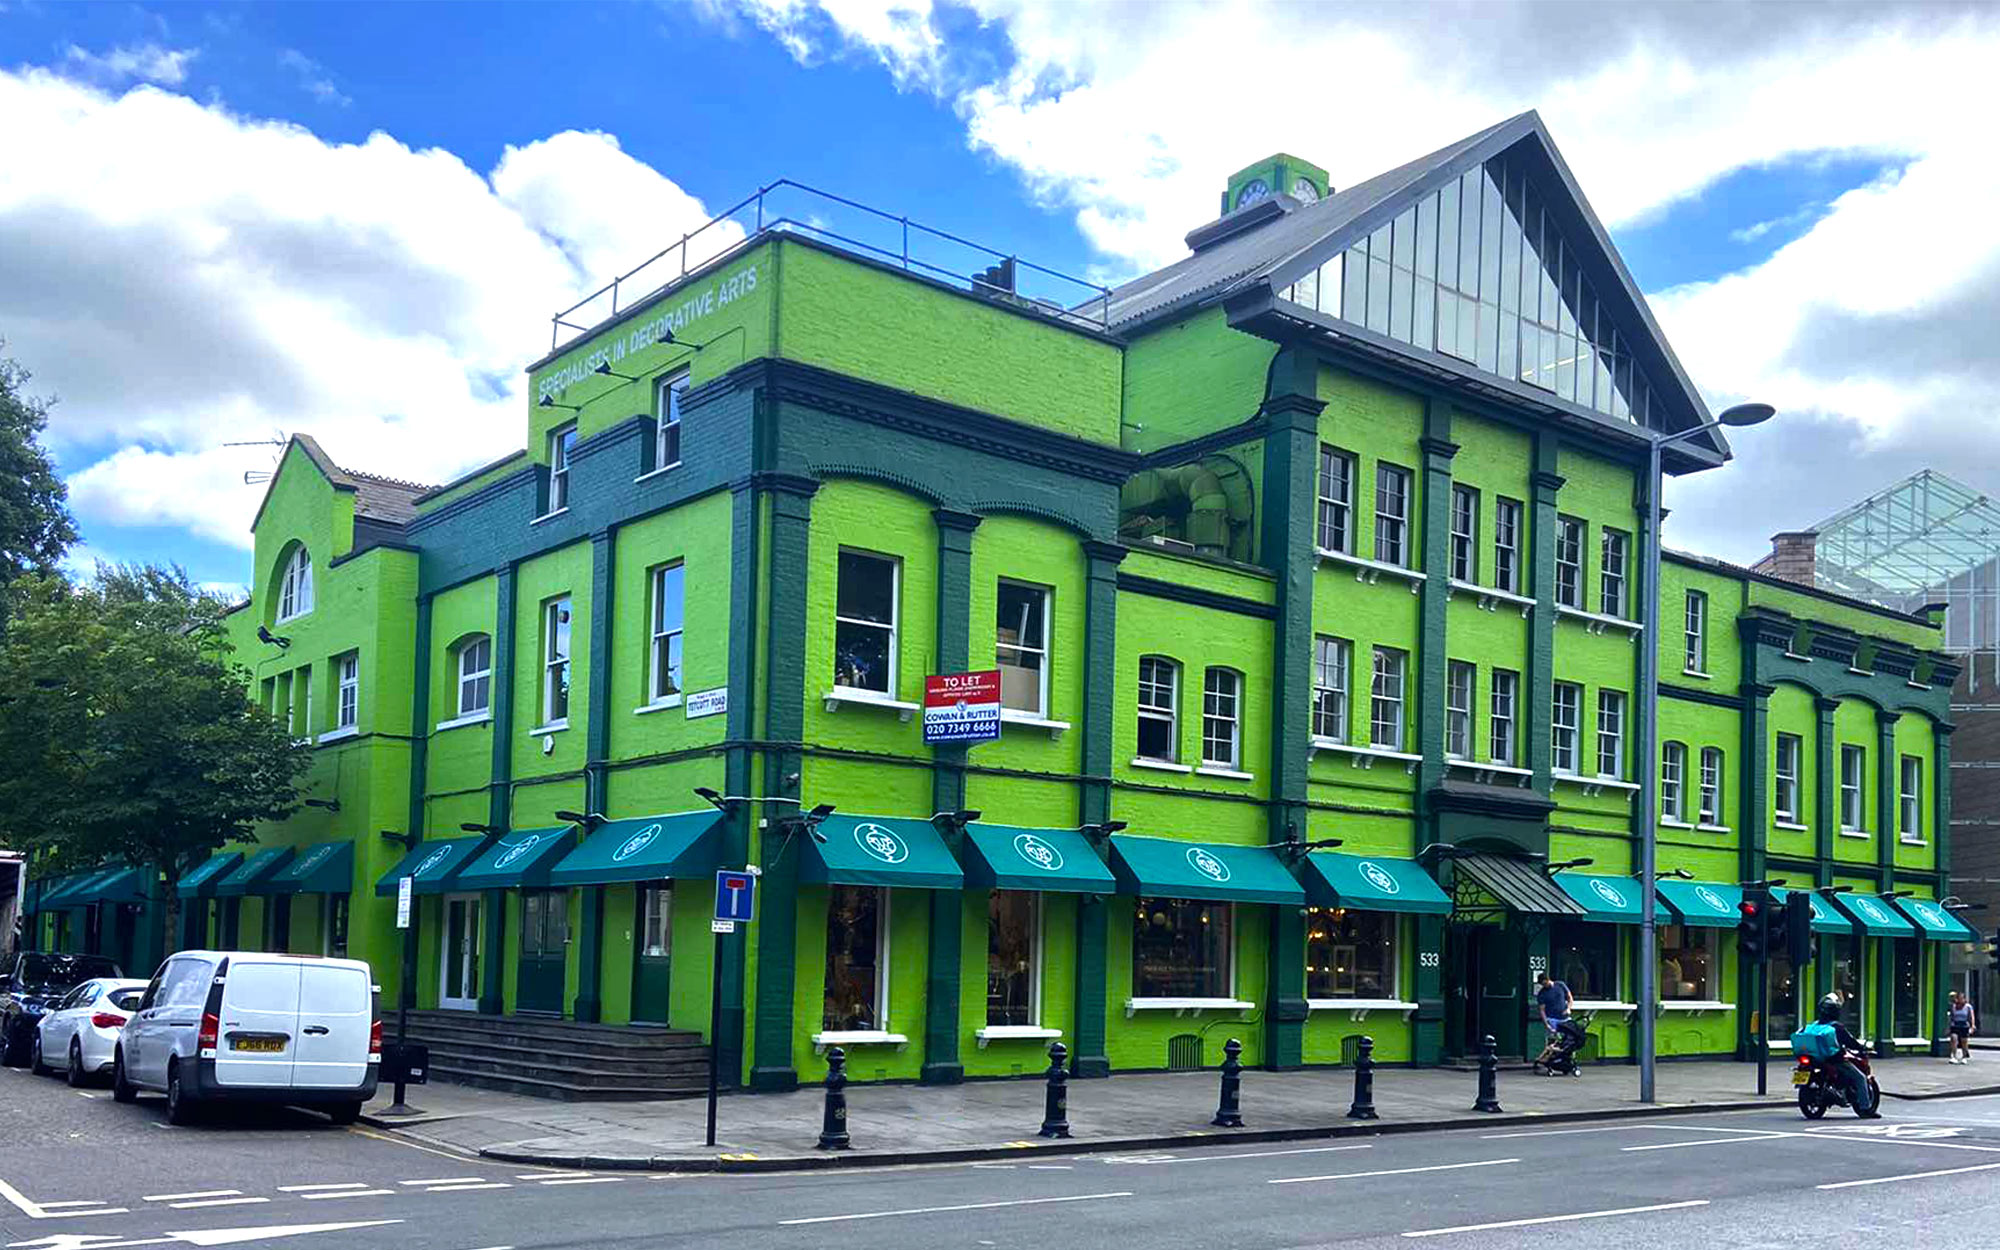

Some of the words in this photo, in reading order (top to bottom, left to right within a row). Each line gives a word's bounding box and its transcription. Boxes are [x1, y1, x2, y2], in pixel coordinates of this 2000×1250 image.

[614, 339, 625, 362] IN
[630, 288, 714, 354] DECORATIVE
[718, 265, 758, 309] ARTS
[943, 677, 959, 687] TO
[961, 676, 981, 686] LET
[926, 713, 958, 722] COWAN
[959, 712, 965, 720] &
[967, 710, 997, 719] RUTTER
[926, 725, 945, 734] 020
[948, 723, 971, 733] 7349
[973, 721, 996, 731] 6666
[1420, 953, 1439, 966] 533
[1529, 956, 1546, 970] 533
